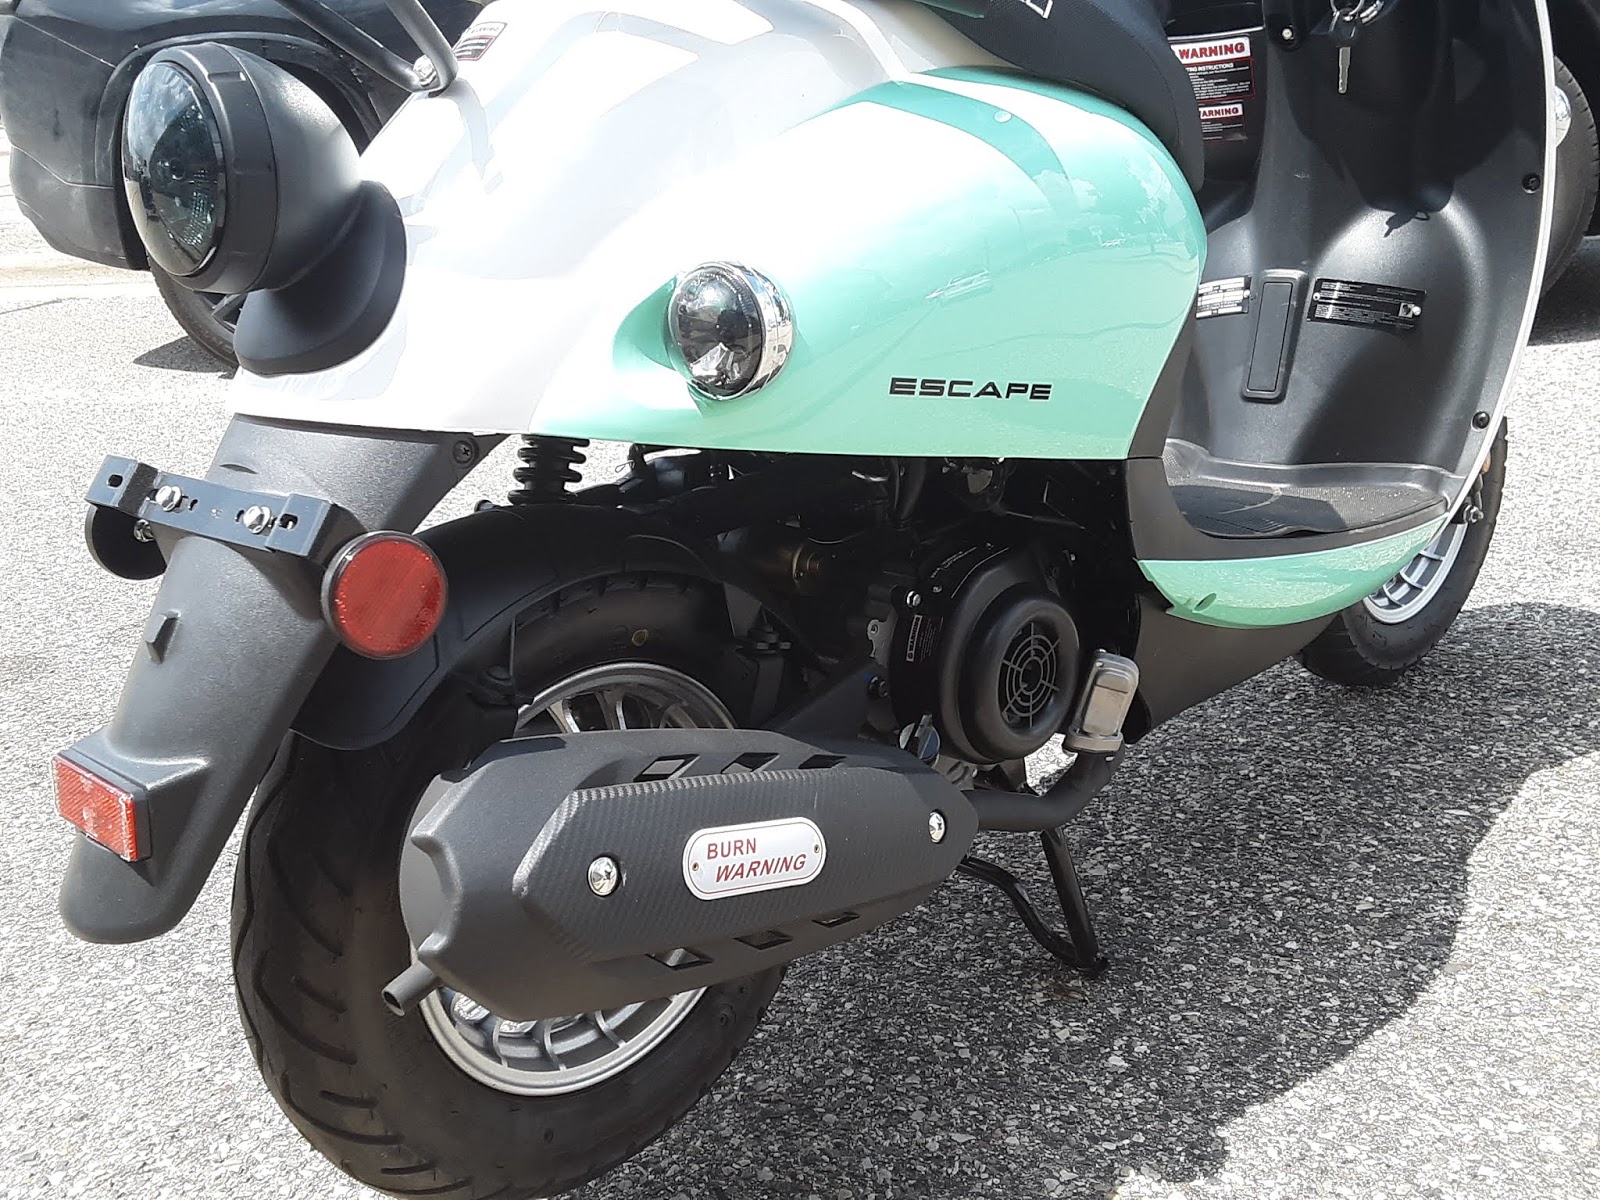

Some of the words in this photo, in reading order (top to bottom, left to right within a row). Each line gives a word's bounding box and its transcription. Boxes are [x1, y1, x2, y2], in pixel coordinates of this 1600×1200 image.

[1179, 42, 1245, 59] WARNING
[1198, 62, 1234, 72] INSTRUCTIONS
[1202, 107, 1239, 117] ARNING
[889, 377, 1052, 400] ESCAPE
[707, 838, 757, 860] BURN
[715, 854, 807, 883] WARNING
